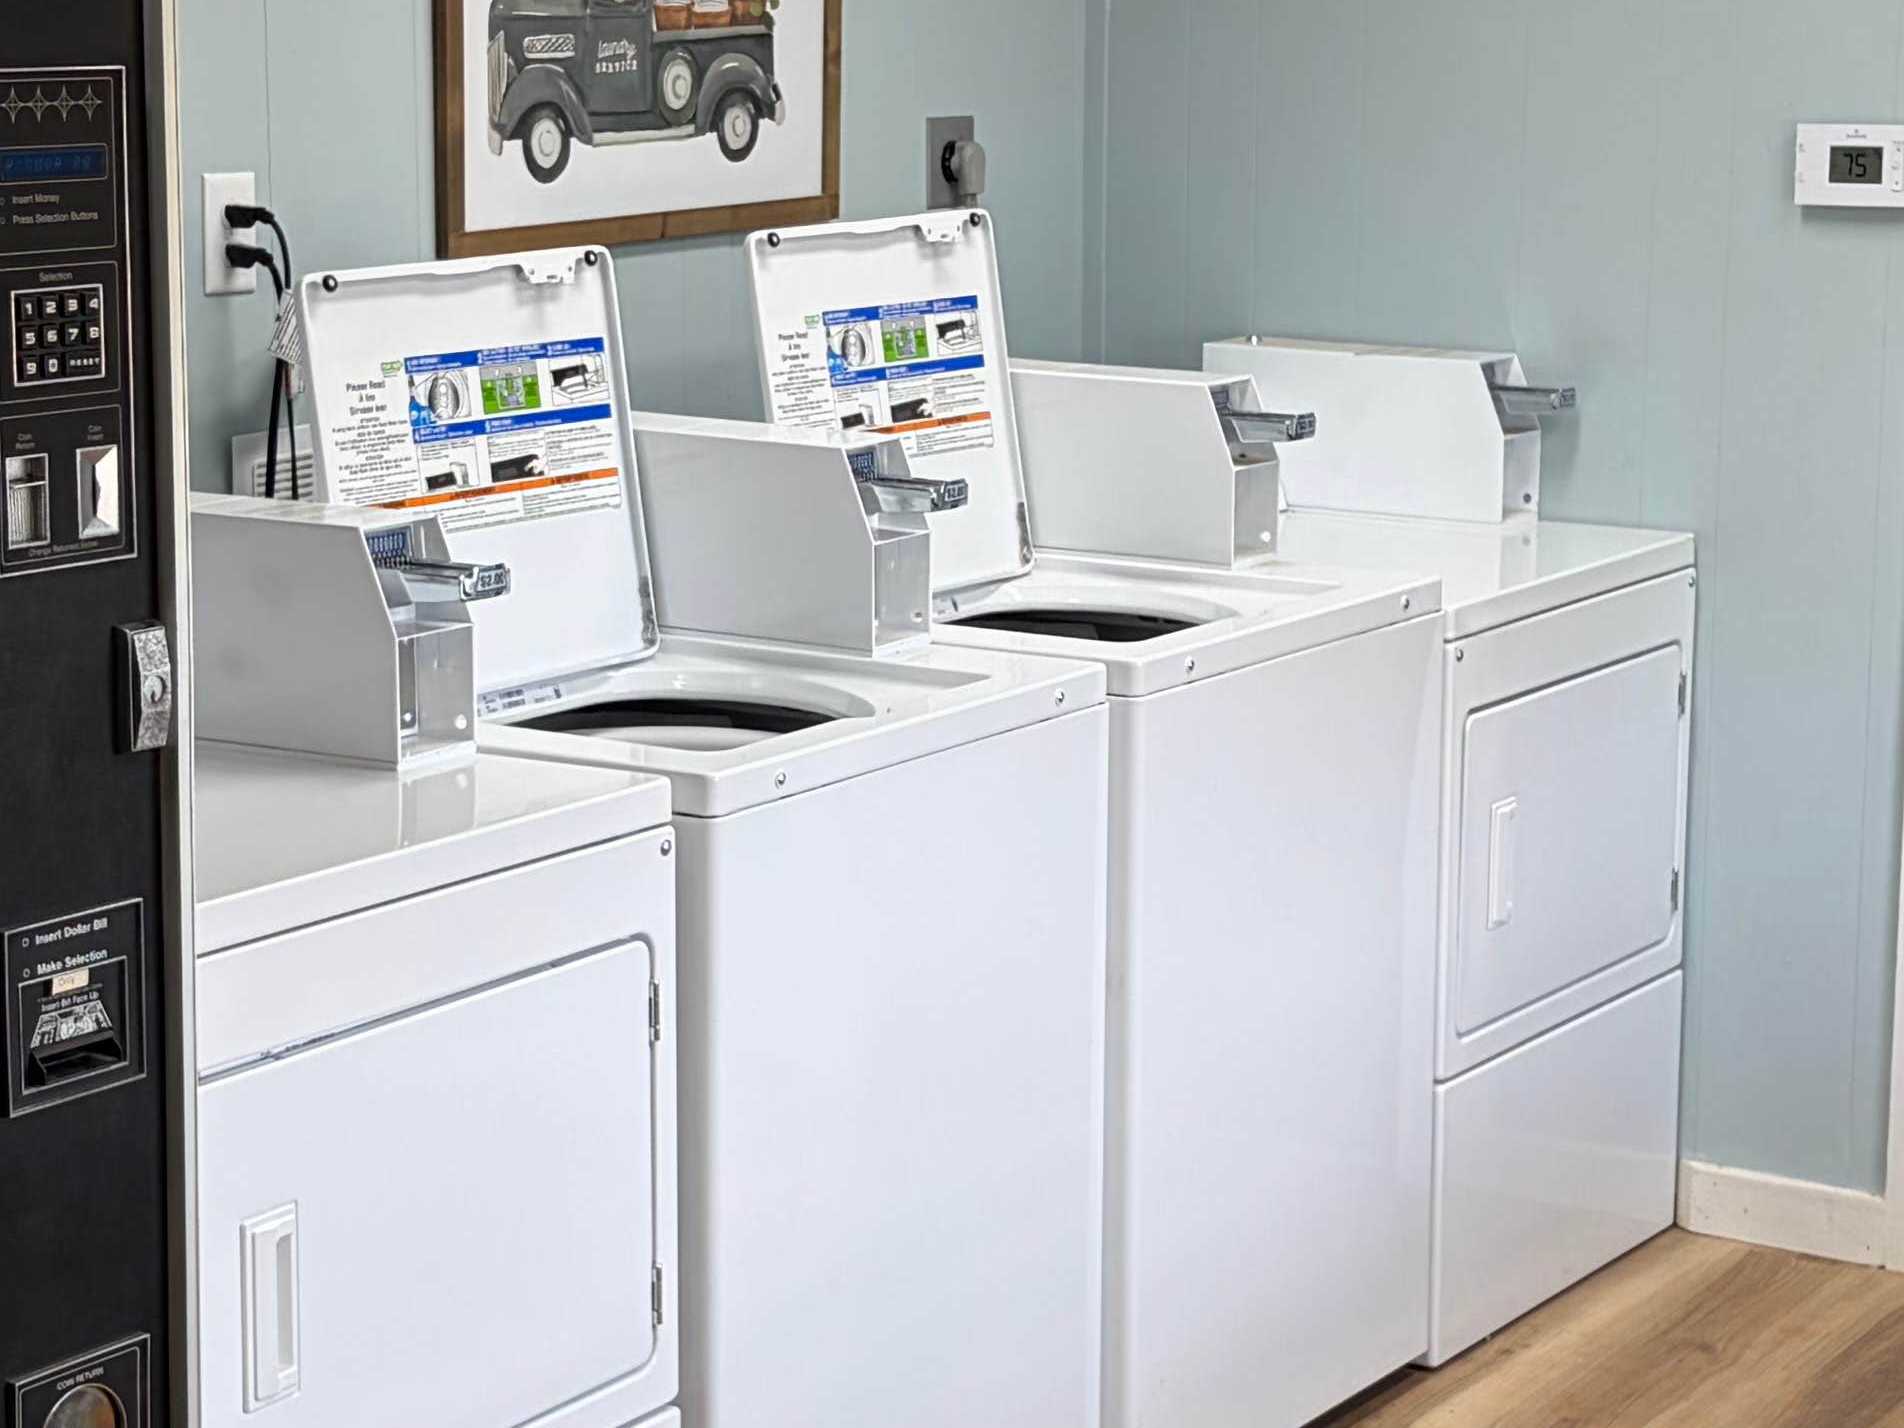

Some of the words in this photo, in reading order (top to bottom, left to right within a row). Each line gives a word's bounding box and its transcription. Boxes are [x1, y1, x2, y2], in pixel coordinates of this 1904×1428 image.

[1842, 153, 1867, 178] 75
[34, 193, 60, 205] Money
[35, 212, 70, 224] Selection
[24, 302, 33, 315] 1
[45, 300, 57, 314] 2
[67, 298, 78, 312] 3
[88, 297, 99, 310] 4
[24, 331, 36, 345] 5
[46, 329, 58, 343] 6
[67, 327, 79, 341] 7
[89, 326, 100, 339] 8
[26, 362, 37, 375] 9
[48, 358, 59, 373] 0
[69, 357, 101, 367] RESET
[35, 930, 63, 946] Insert
[63, 922, 91, 939] Dollar
[93, 917, 109, 931] Bill
[36, 960, 64, 976] Make
[64, 948, 109, 969] Selection
